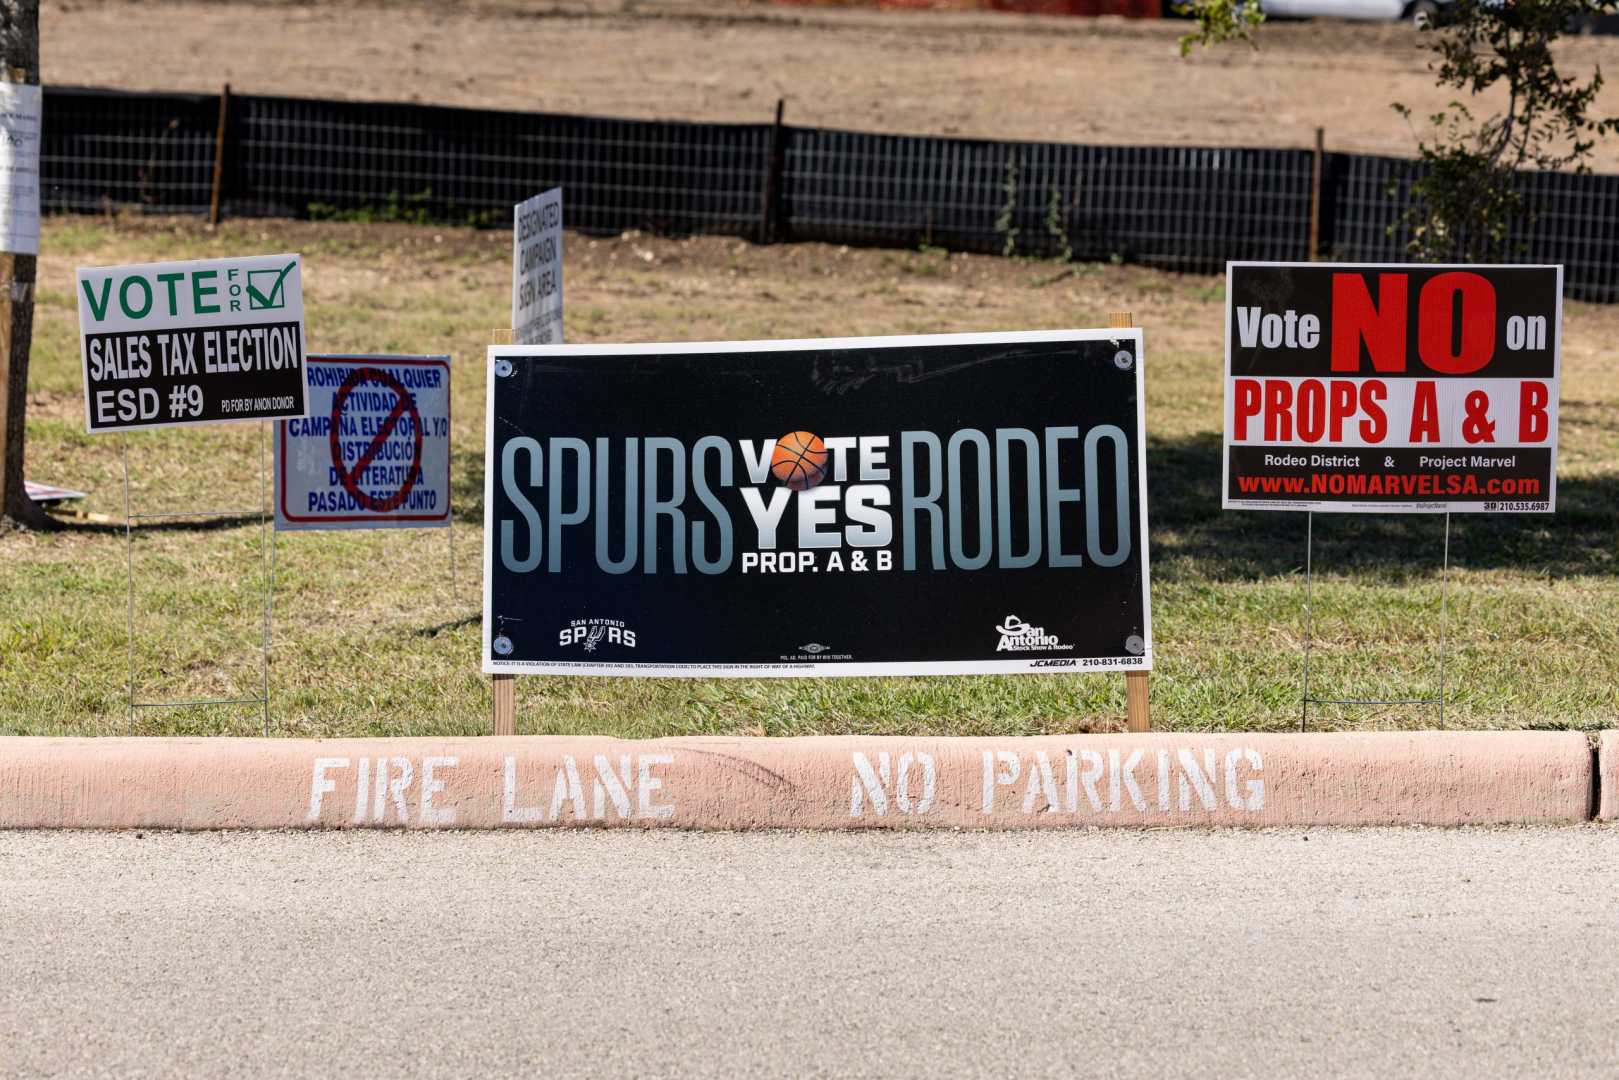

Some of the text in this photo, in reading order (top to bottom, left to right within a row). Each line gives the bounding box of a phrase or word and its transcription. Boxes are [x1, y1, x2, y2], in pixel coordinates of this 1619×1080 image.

[81, 270, 221, 322] VOTE
[1237, 272, 1546, 375] Vote NO on
[90, 326, 298, 381] SALES TAX ELECTION
[96, 384, 204, 423] ESD #9
[221, 399, 231, 413] PD
[231, 399, 244, 413] FOR
[244, 398, 253, 412] BY
[272, 396, 295, 410] DONOR
[1233, 378, 1549, 444] PROPS A & B
[1264, 454, 1516, 471] Rodeo District & Project Marvel
[900, 424, 1132, 571] RODEO
[1238, 474, 1540, 495] www.NOMARVELSA.com
[500, 435, 733, 575] SPURS
[739, 484, 893, 550] YES
[1499, 502, 1550, 511] 210.535.6987
[741, 550, 893, 573] PROP. A & B
[559, 626, 636, 650] SPURS
[571, 618, 625, 628] SAN ANTONIO
[996, 635, 1059, 651] Antonio
[1030, 658, 1143, 667] JCMEDIA 210-831-6838
[306, 753, 676, 824] FIRE LANE
[850, 746, 1266, 818] NO PARKING
